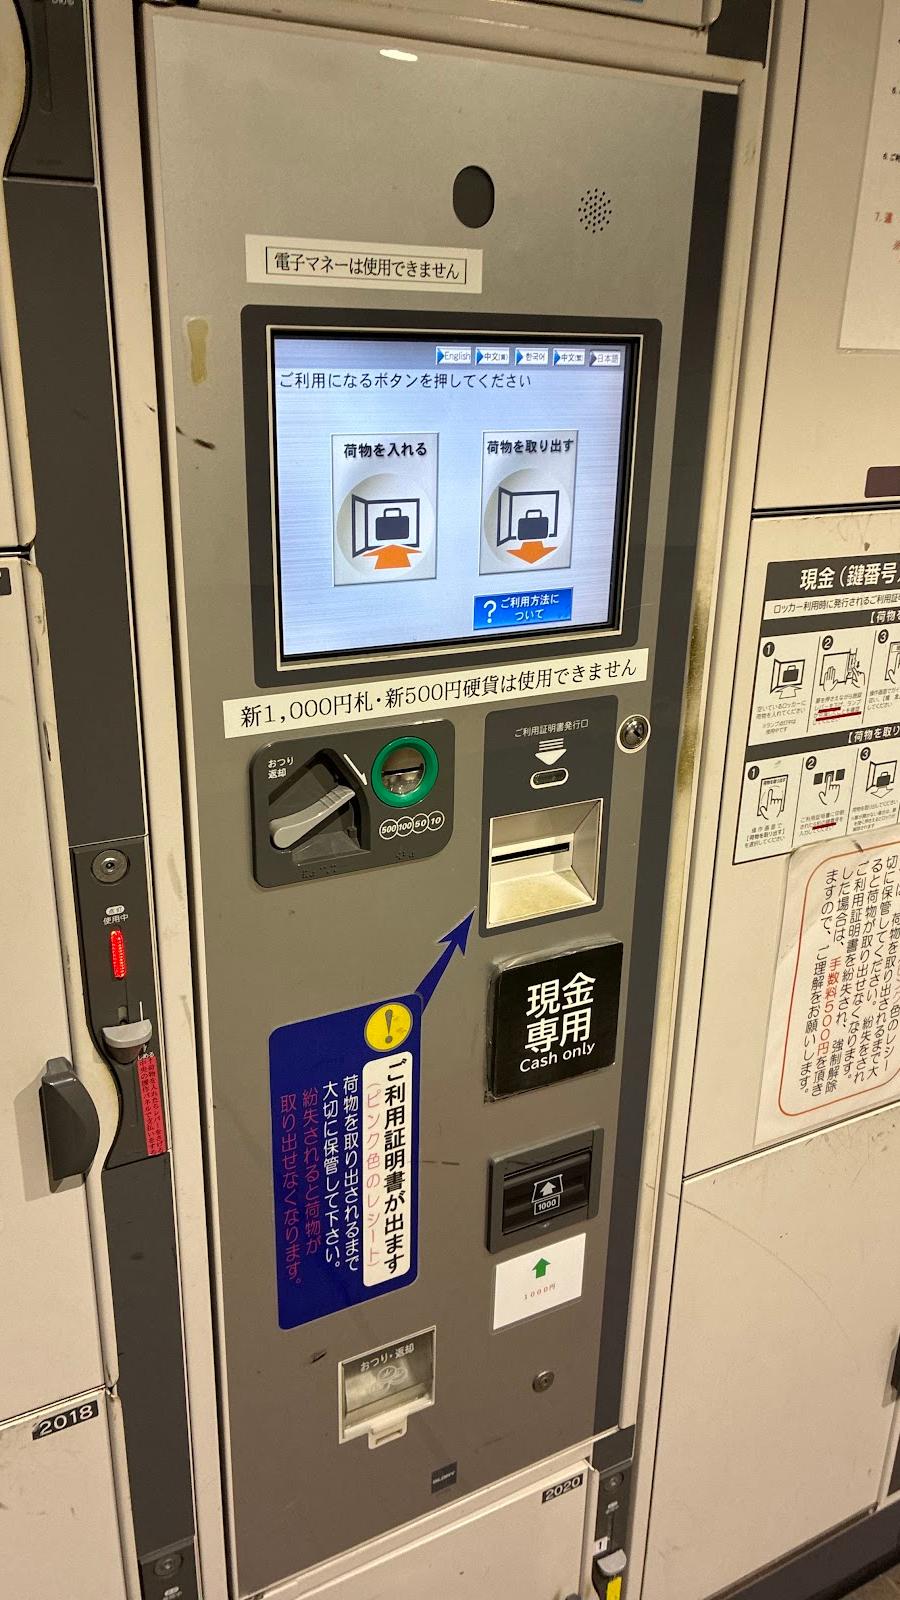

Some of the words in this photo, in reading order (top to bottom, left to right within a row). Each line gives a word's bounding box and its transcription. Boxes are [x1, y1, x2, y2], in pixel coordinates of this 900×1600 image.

[274, 252, 460, 280] 電子マネーは使用できません
[444, 351, 471, 362] English
[525, 352, 546, 362] 한국어
[596, 353, 619, 364] 日本語
[279, 371, 532, 390] ご利用になるボタンを押してください
[343, 441, 428, 459] 荷物を入れる
[486, 438, 574, 455] 荷物を取り出す
[799, 561, 900, 591] 現金（鍵番号
[500, 593, 560, 609] ご利用方法に
[514, 608, 545, 621] ついて
[240, 658, 637, 728] 新1,000円札・新500円硬貨は使用できません
[514, 718, 589, 738] ご利用証明書発行口
[267, 756, 294, 768] おつり
[267, 768, 287, 779] 返却
[381, 824, 397, 834] 500
[399, 821, 413, 831] 100
[414, 819, 427, 829] 50
[430, 816, 441, 825] 10
[103, 913, 129, 926] 使用中
[525, 971, 596, 1019] 現金
[524, 1007, 592, 1054] 専用
[519, 1051, 558, 1073] Cash
[562, 1041, 596, 1060] only
[302, 1087, 321, 1256] 紛失されると荷物が
[322, 1081, 340, 1268] 大切に保管して下さい。
[343, 1074, 360, 1271] 荷物を取り出されるまで
[384, 1058, 407, 1274] ご利用証明書が出ます
[280, 1093, 302, 1284] 取り出せなくなります。
[538, 1198, 557, 1212] 1000
[360, 1342, 415, 1373] おつり・返却
[39, 1403, 94, 1437] 2018
[545, 1476, 581, 1501] 2020
